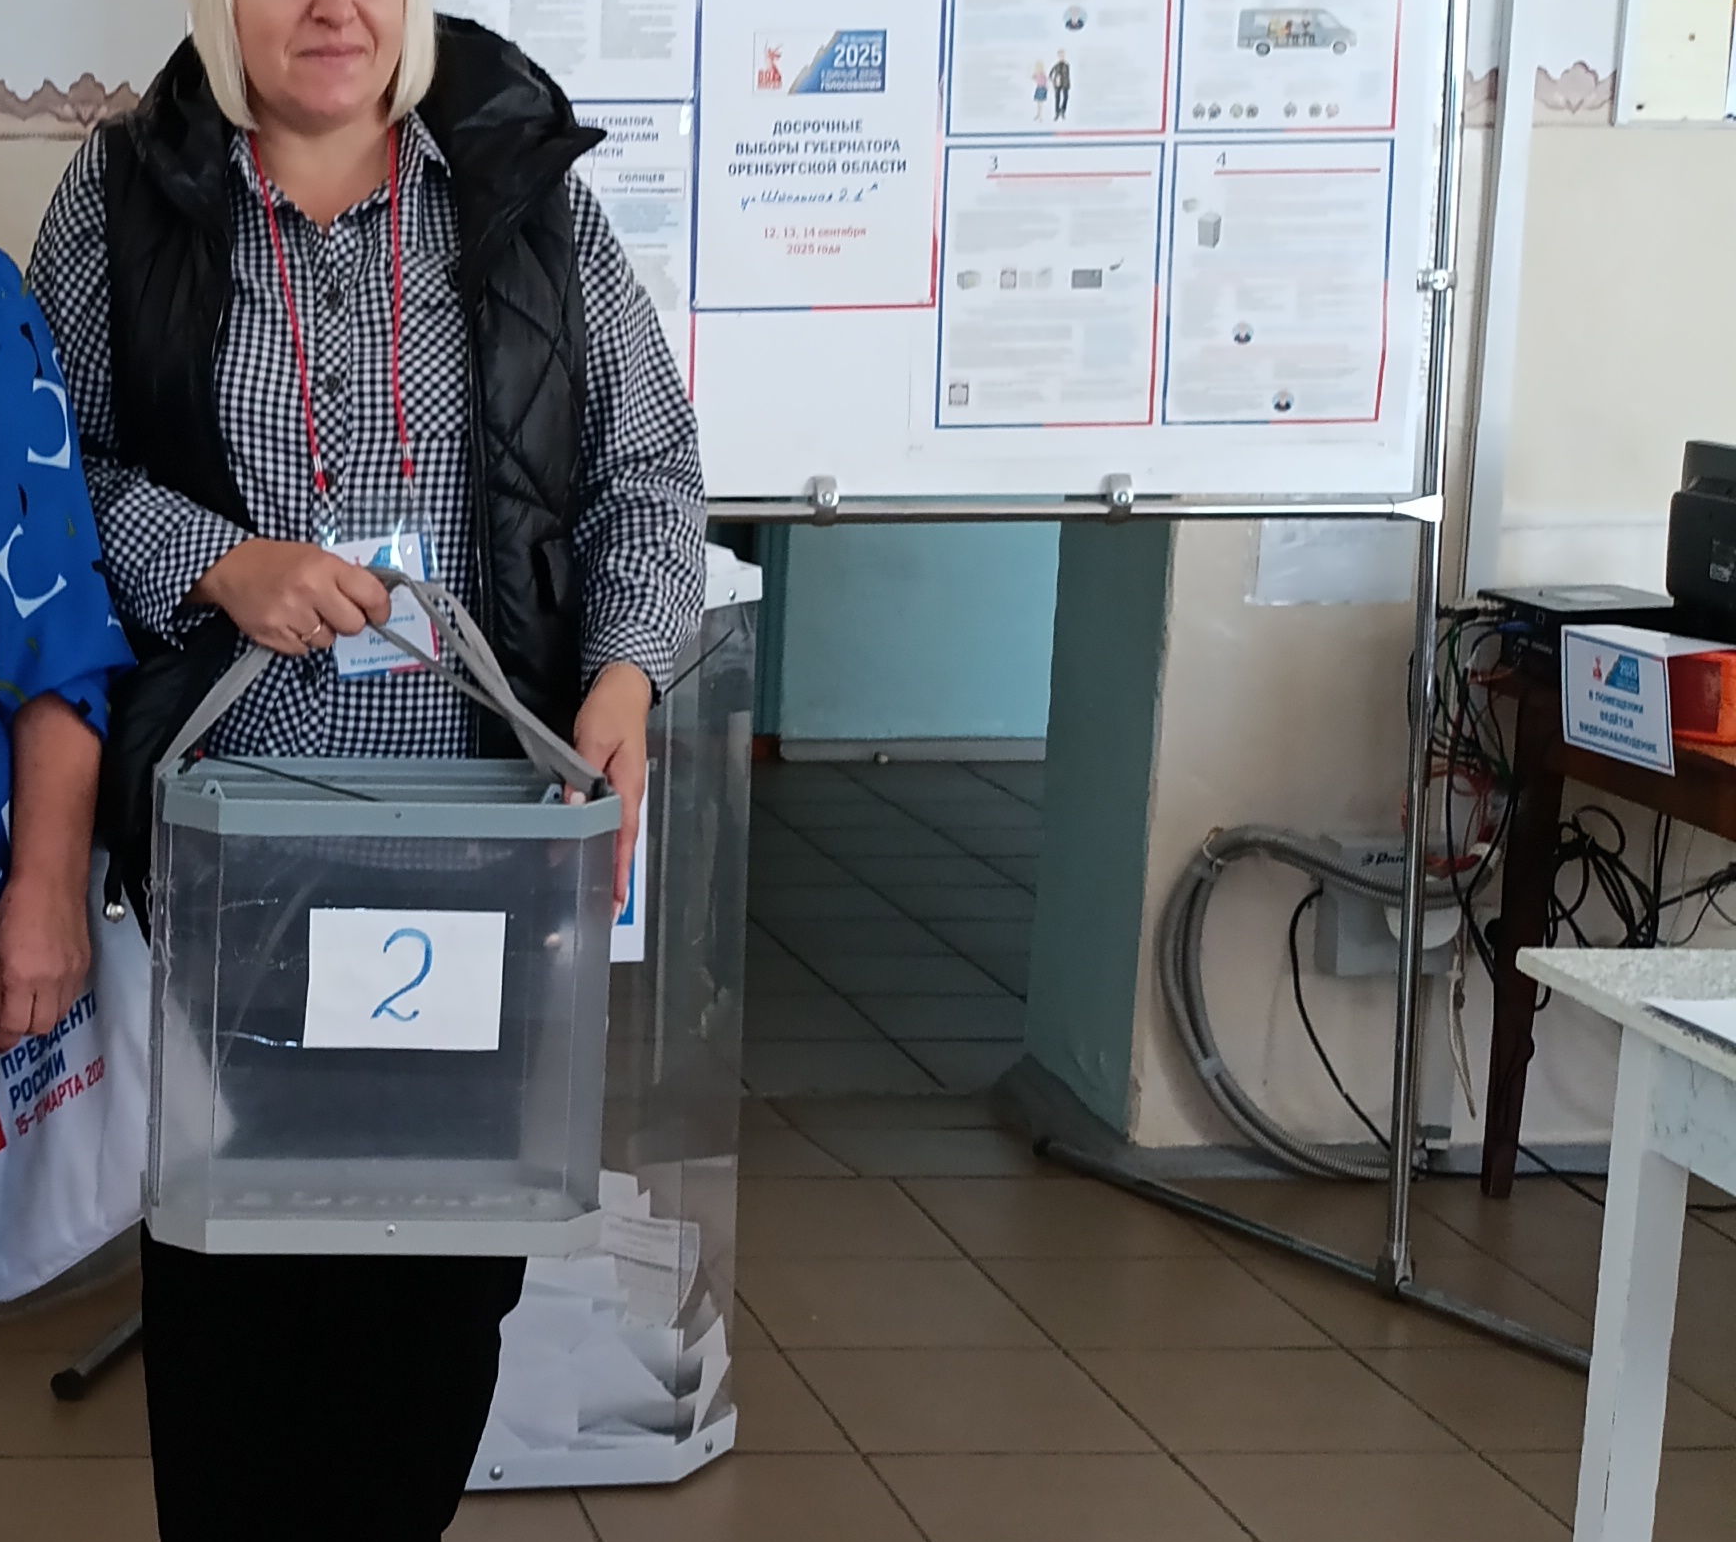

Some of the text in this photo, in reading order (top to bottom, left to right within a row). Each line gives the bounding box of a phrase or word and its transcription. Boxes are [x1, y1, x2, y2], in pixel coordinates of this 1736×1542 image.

[833, 44, 882, 69] 2025
[602, 116, 654, 127] СЕНАТОРА
[772, 120, 864, 136] ДОСРОЧНЫЕ
[735, 139, 901, 157] ВЫБОРЫ ГУБЕРНАТОРА
[728, 157, 907, 177] ОРЕНБУРГСКОЙ ОБЛАСТИ
[988, 155, 998, 172] 3
[1216, 152, 1227, 168] 4
[803, 227, 815, 238] 14
[817, 227, 867, 239] сентября
[370, 926, 435, 1023] 2
